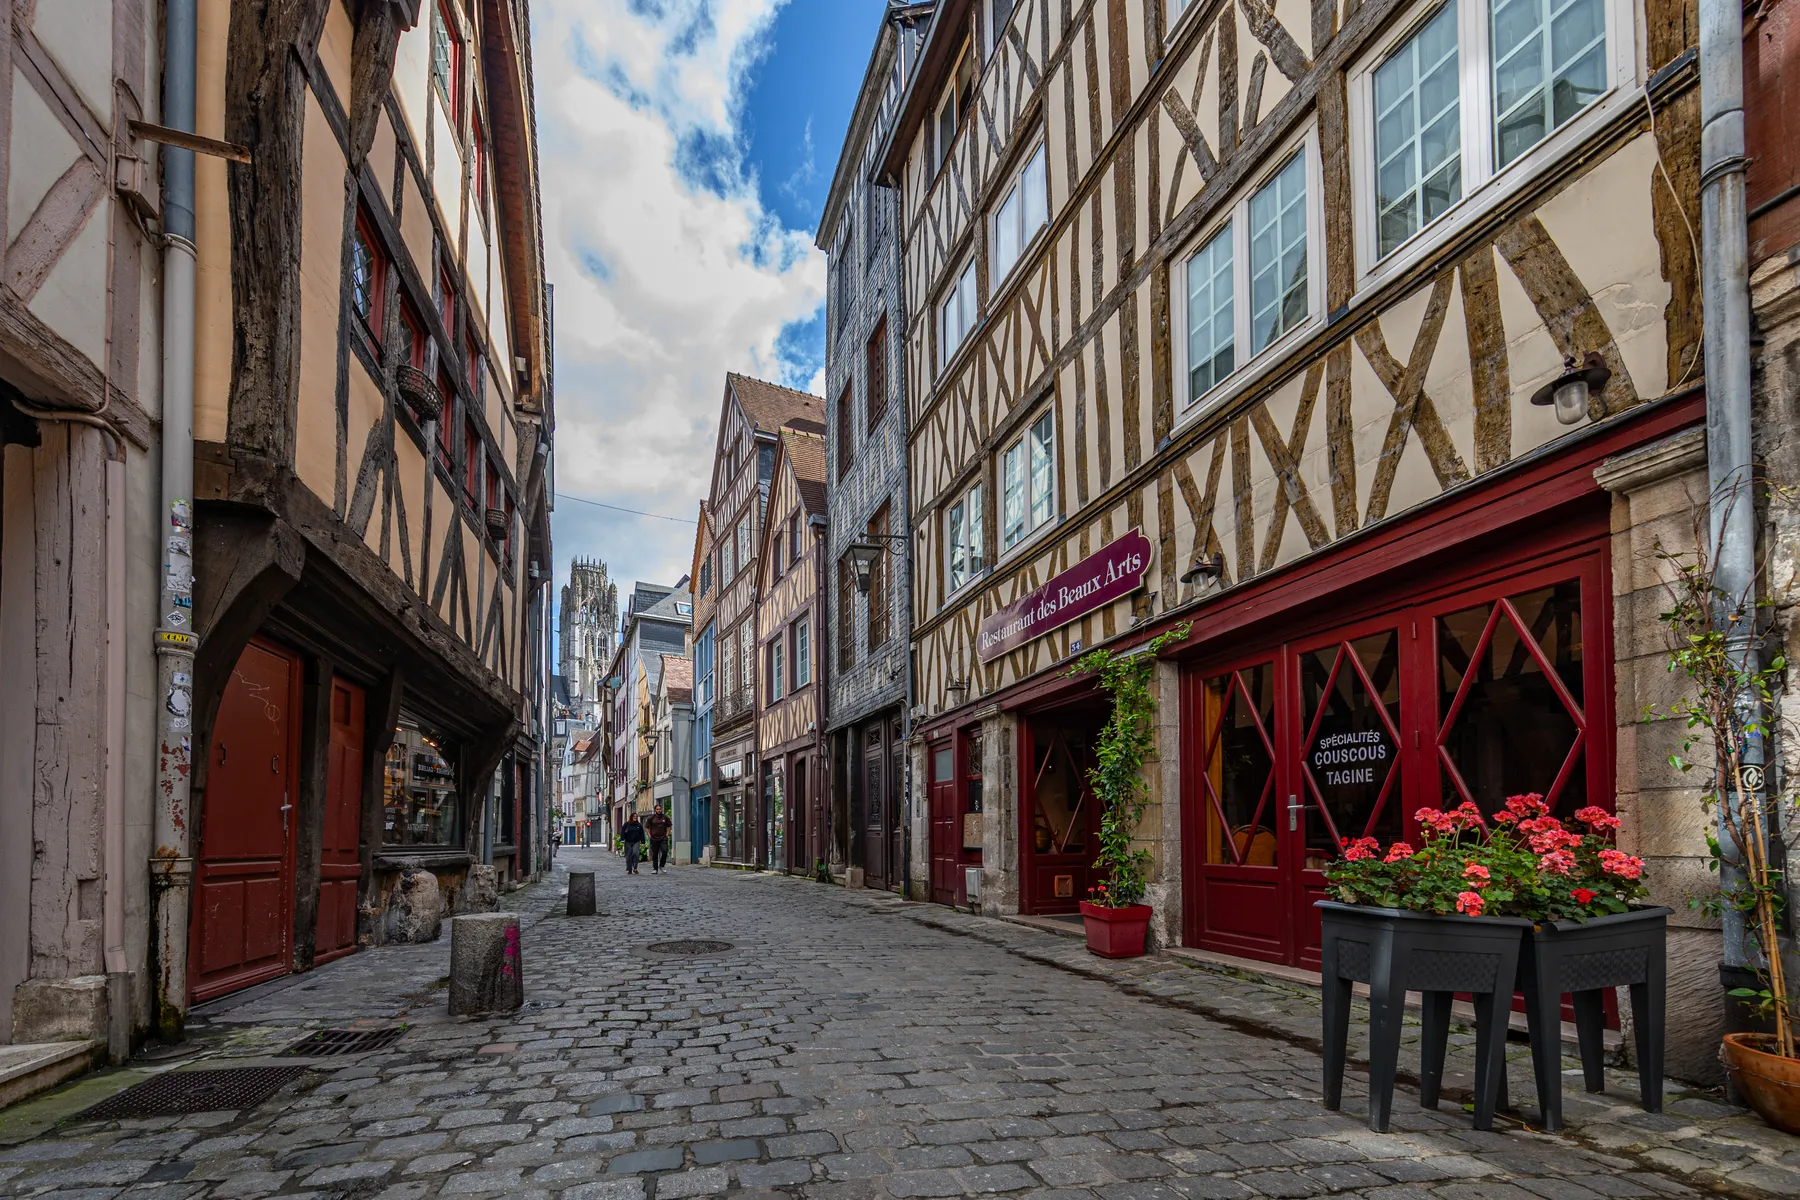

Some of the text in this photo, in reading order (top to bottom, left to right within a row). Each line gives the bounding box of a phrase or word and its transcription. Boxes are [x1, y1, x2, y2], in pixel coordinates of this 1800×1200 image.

[981, 552, 1142, 650] Restaurant des Beaux Arts
[1071, 641, 1080, 651] 34
[1320, 729, 1380, 749] SPÉCIALITÉS
[1315, 745, 1386, 765] COUSCOUS
[1326, 768, 1374, 785] TAGINE
